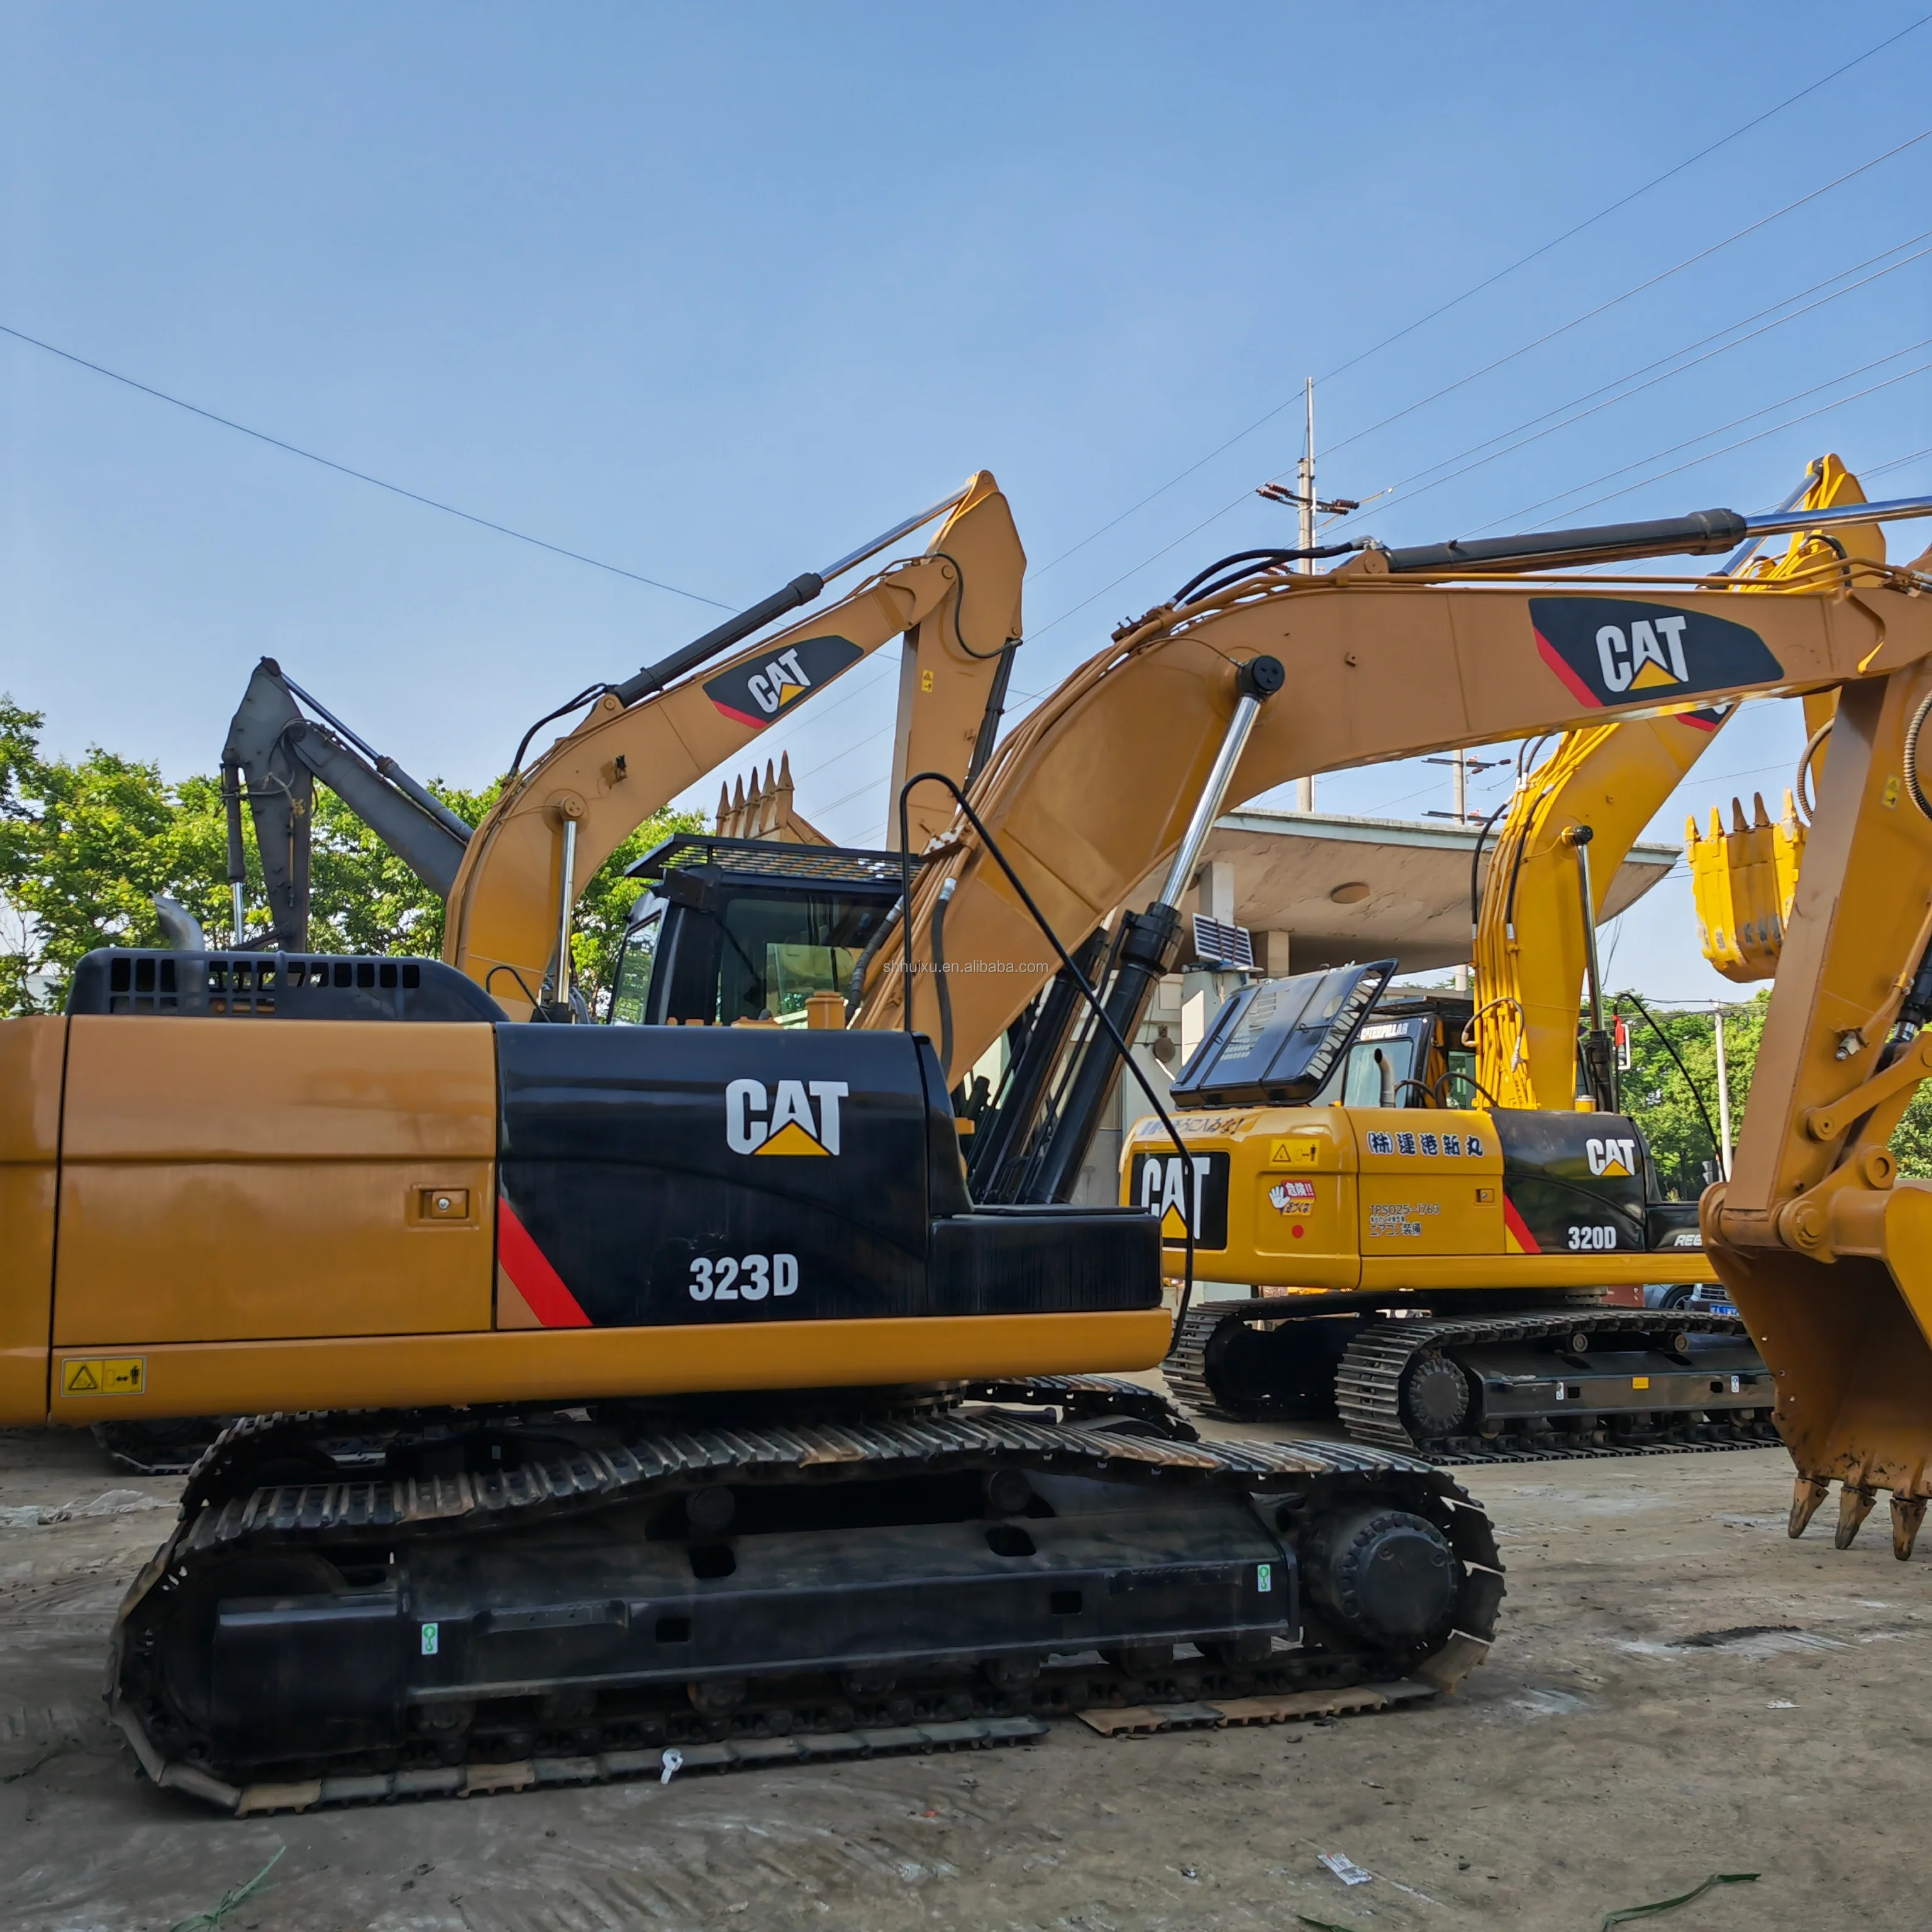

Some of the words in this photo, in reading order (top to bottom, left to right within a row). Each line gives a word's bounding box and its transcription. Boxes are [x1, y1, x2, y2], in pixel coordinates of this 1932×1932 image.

[748, 648, 811, 713] CAT
[1596, 616, 1689, 692] CAT
[726, 1079, 849, 1156] CAT
[1585, 1139, 1635, 1176] CAT
[1141, 1157, 1211, 1240] CAT
[1568, 1226, 1616, 1249] 320D
[689, 1253, 799, 1302] 323D
